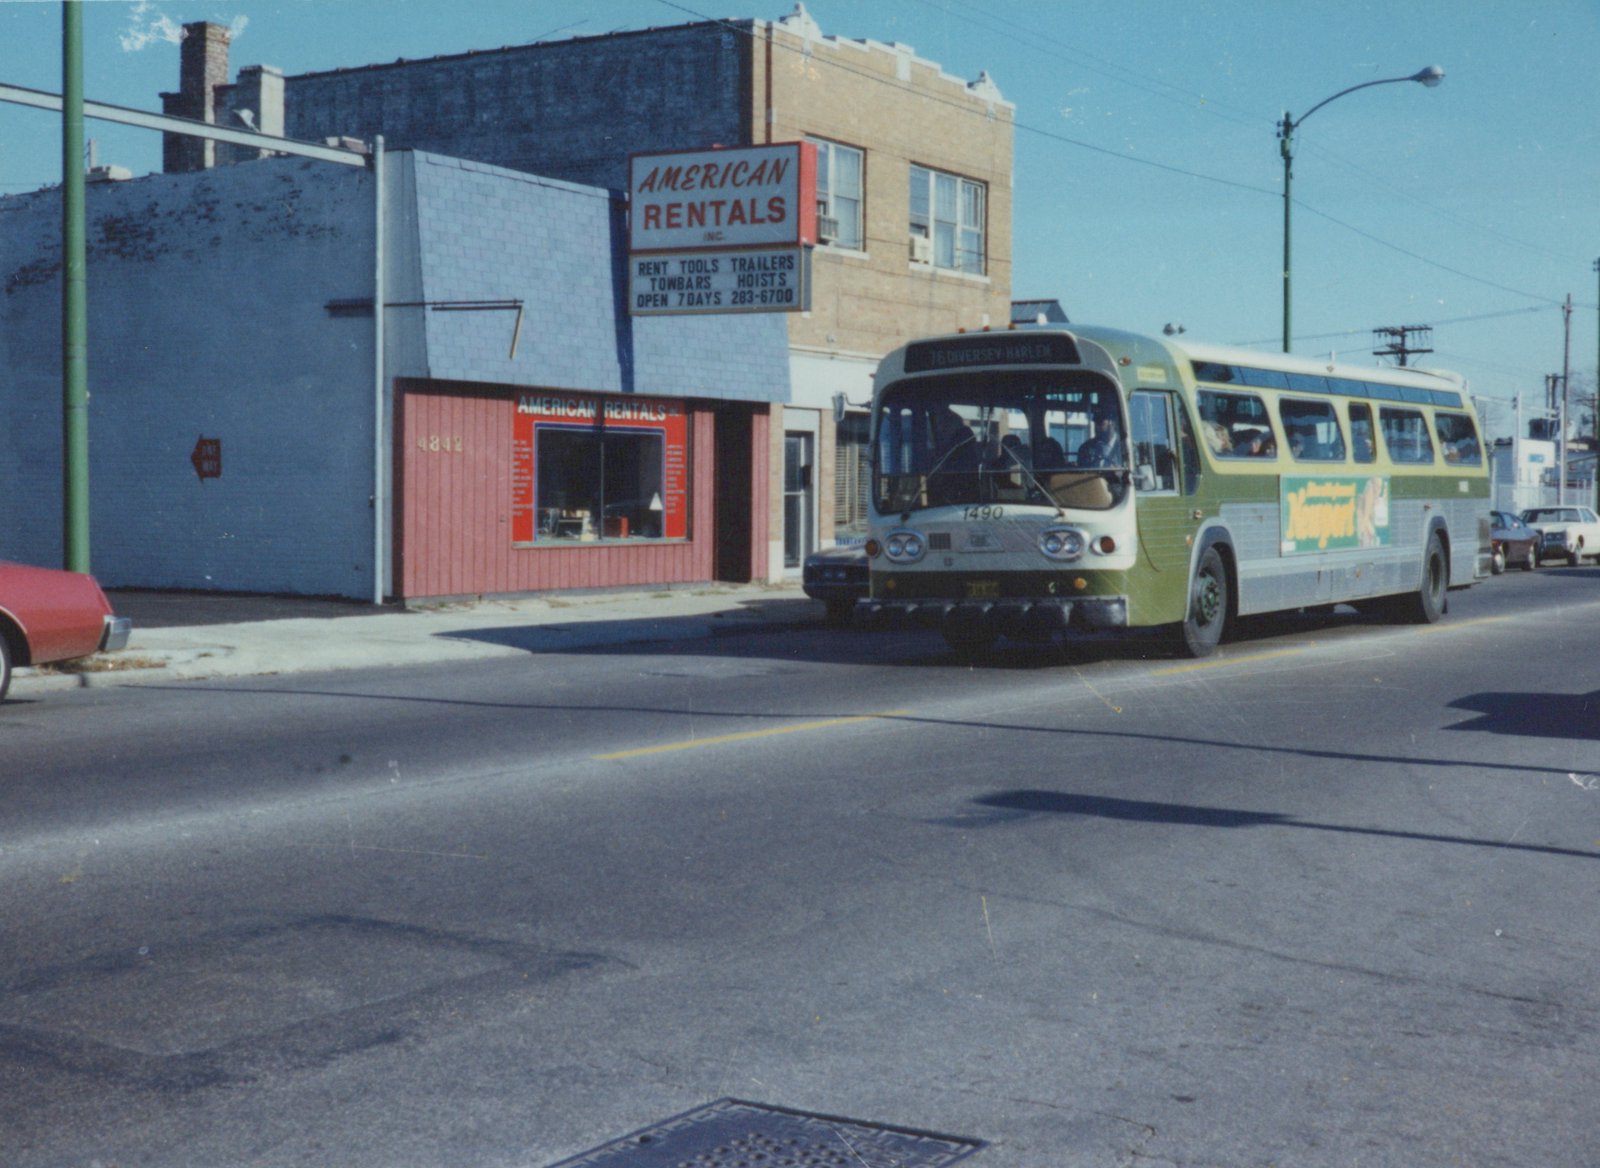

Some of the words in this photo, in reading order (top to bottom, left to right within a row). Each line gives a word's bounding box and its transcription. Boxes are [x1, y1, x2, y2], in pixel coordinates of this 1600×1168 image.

[638, 158, 790, 193] AMERICAN
[643, 196, 786, 230] RENTALS
[638, 261, 668, 276] RENT
[680, 259, 719, 274] TOOLS
[731, 255, 794, 272] TRAILERS
[650, 276, 711, 291] TOWBARS
[737, 273, 786, 288] HOISTS
[637, 294, 668, 307] OPEN
[731, 289, 793, 305] 283-6700
[517, 396, 596, 418] AMERICAN
[604, 402, 666, 421] RENTALS
[963, 507, 1004, 520] 1490
